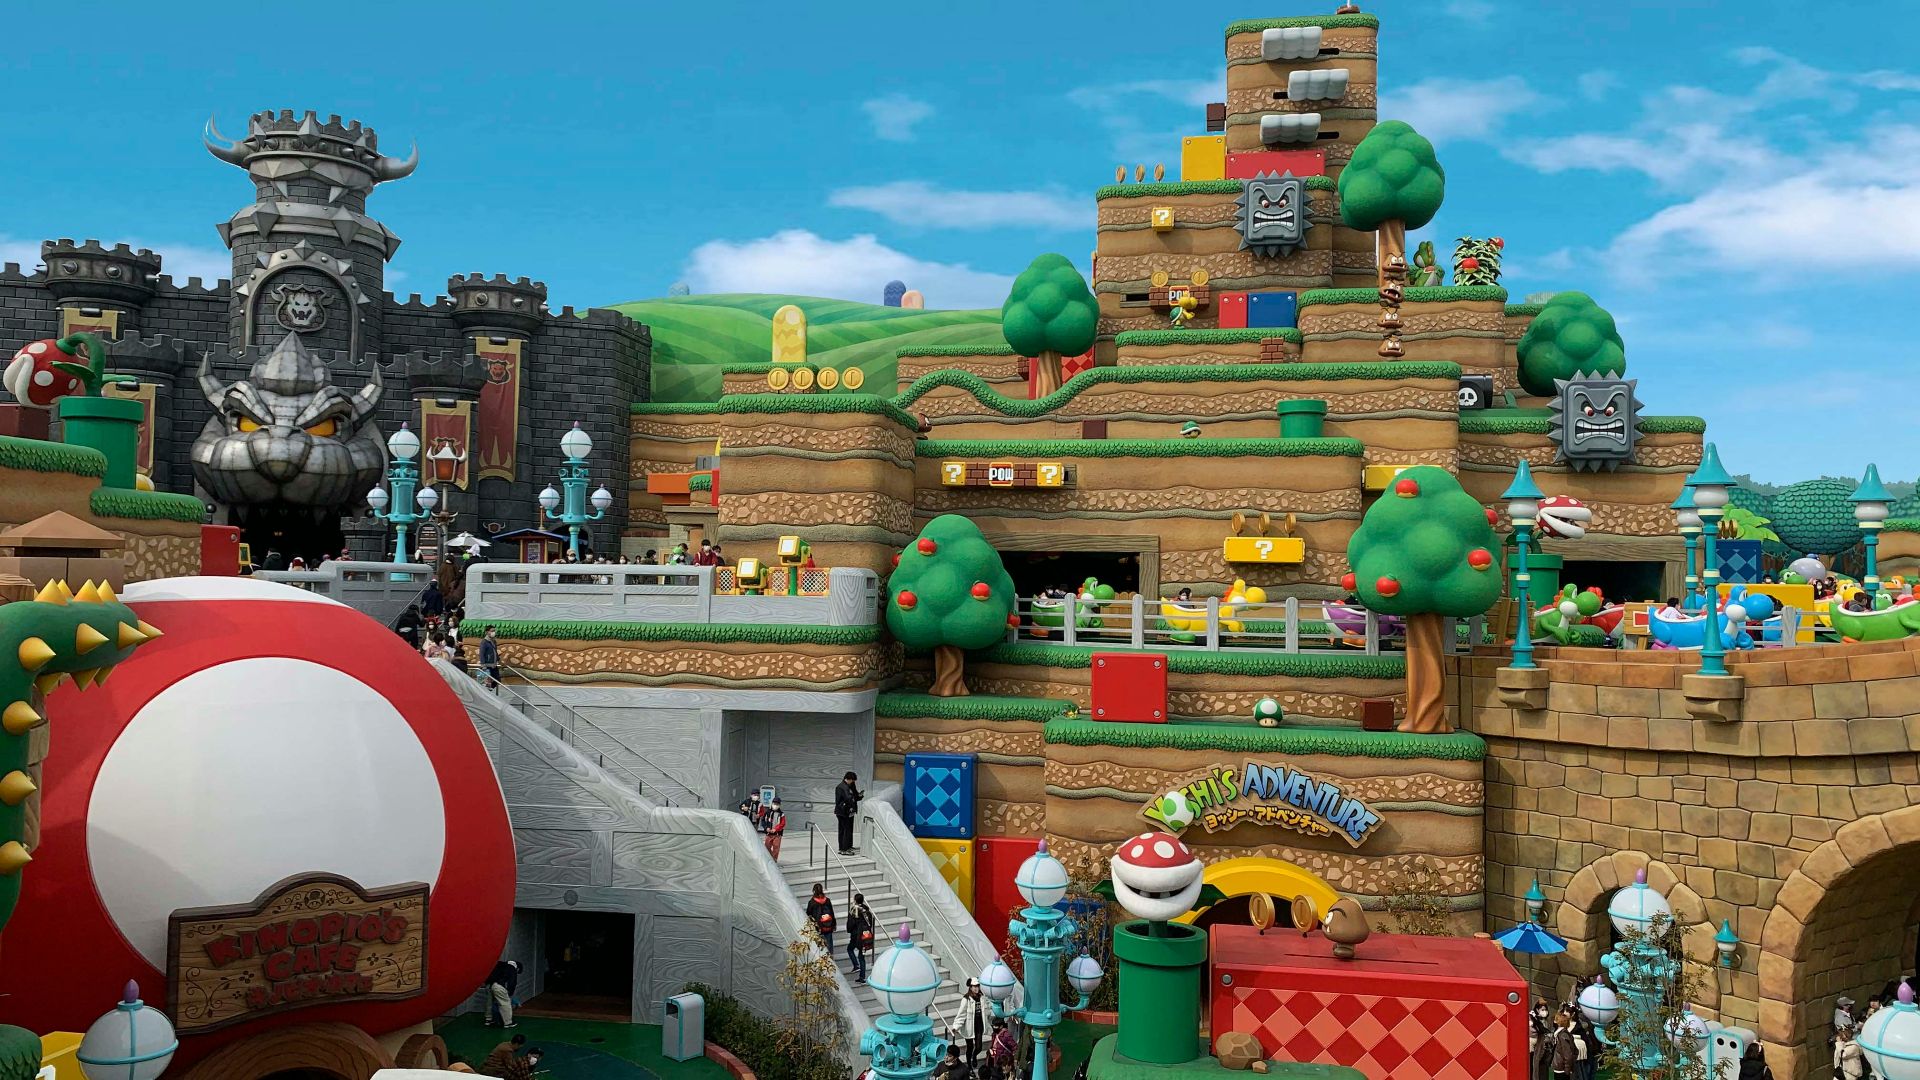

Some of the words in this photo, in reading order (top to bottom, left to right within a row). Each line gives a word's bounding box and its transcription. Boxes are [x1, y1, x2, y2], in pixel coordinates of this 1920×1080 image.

[1155, 209, 1170, 225] ?
[945, 464, 962, 483] ?
[989, 467, 1013, 481] POW
[1040, 465, 1058, 484] ?
[1255, 540, 1273, 560] ?
[1242, 763, 1380, 841] ADVENTURE
[1204, 805, 1330, 831] ヨッシー・アドベンチャー
[204, 908, 409, 968] KINOPIO'S
[263, 943, 361, 981] CAFE
